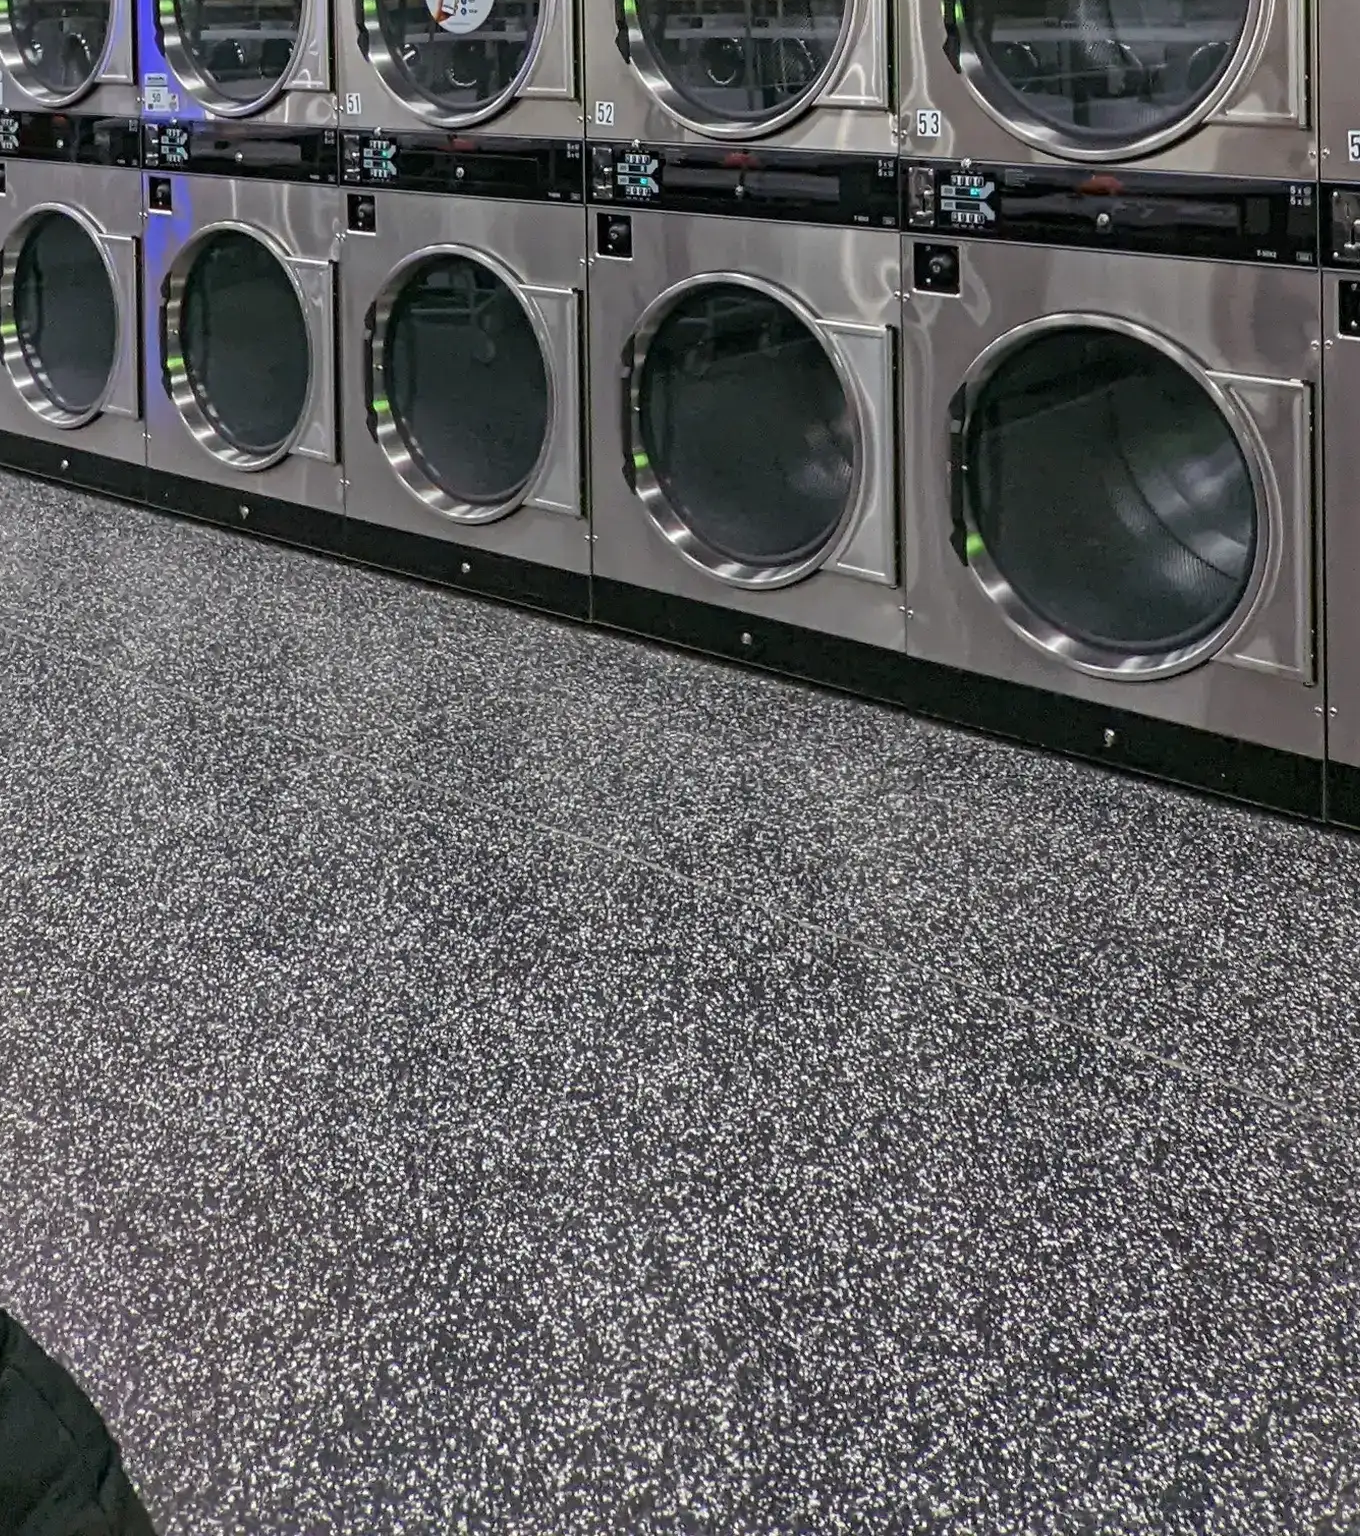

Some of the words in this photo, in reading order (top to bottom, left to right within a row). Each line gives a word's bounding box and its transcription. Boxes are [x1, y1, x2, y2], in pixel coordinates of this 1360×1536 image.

[152, 93, 161, 103] 50
[347, 96, 360, 112] 51
[597, 104, 613, 124] 52
[919, 113, 939, 135] 53
